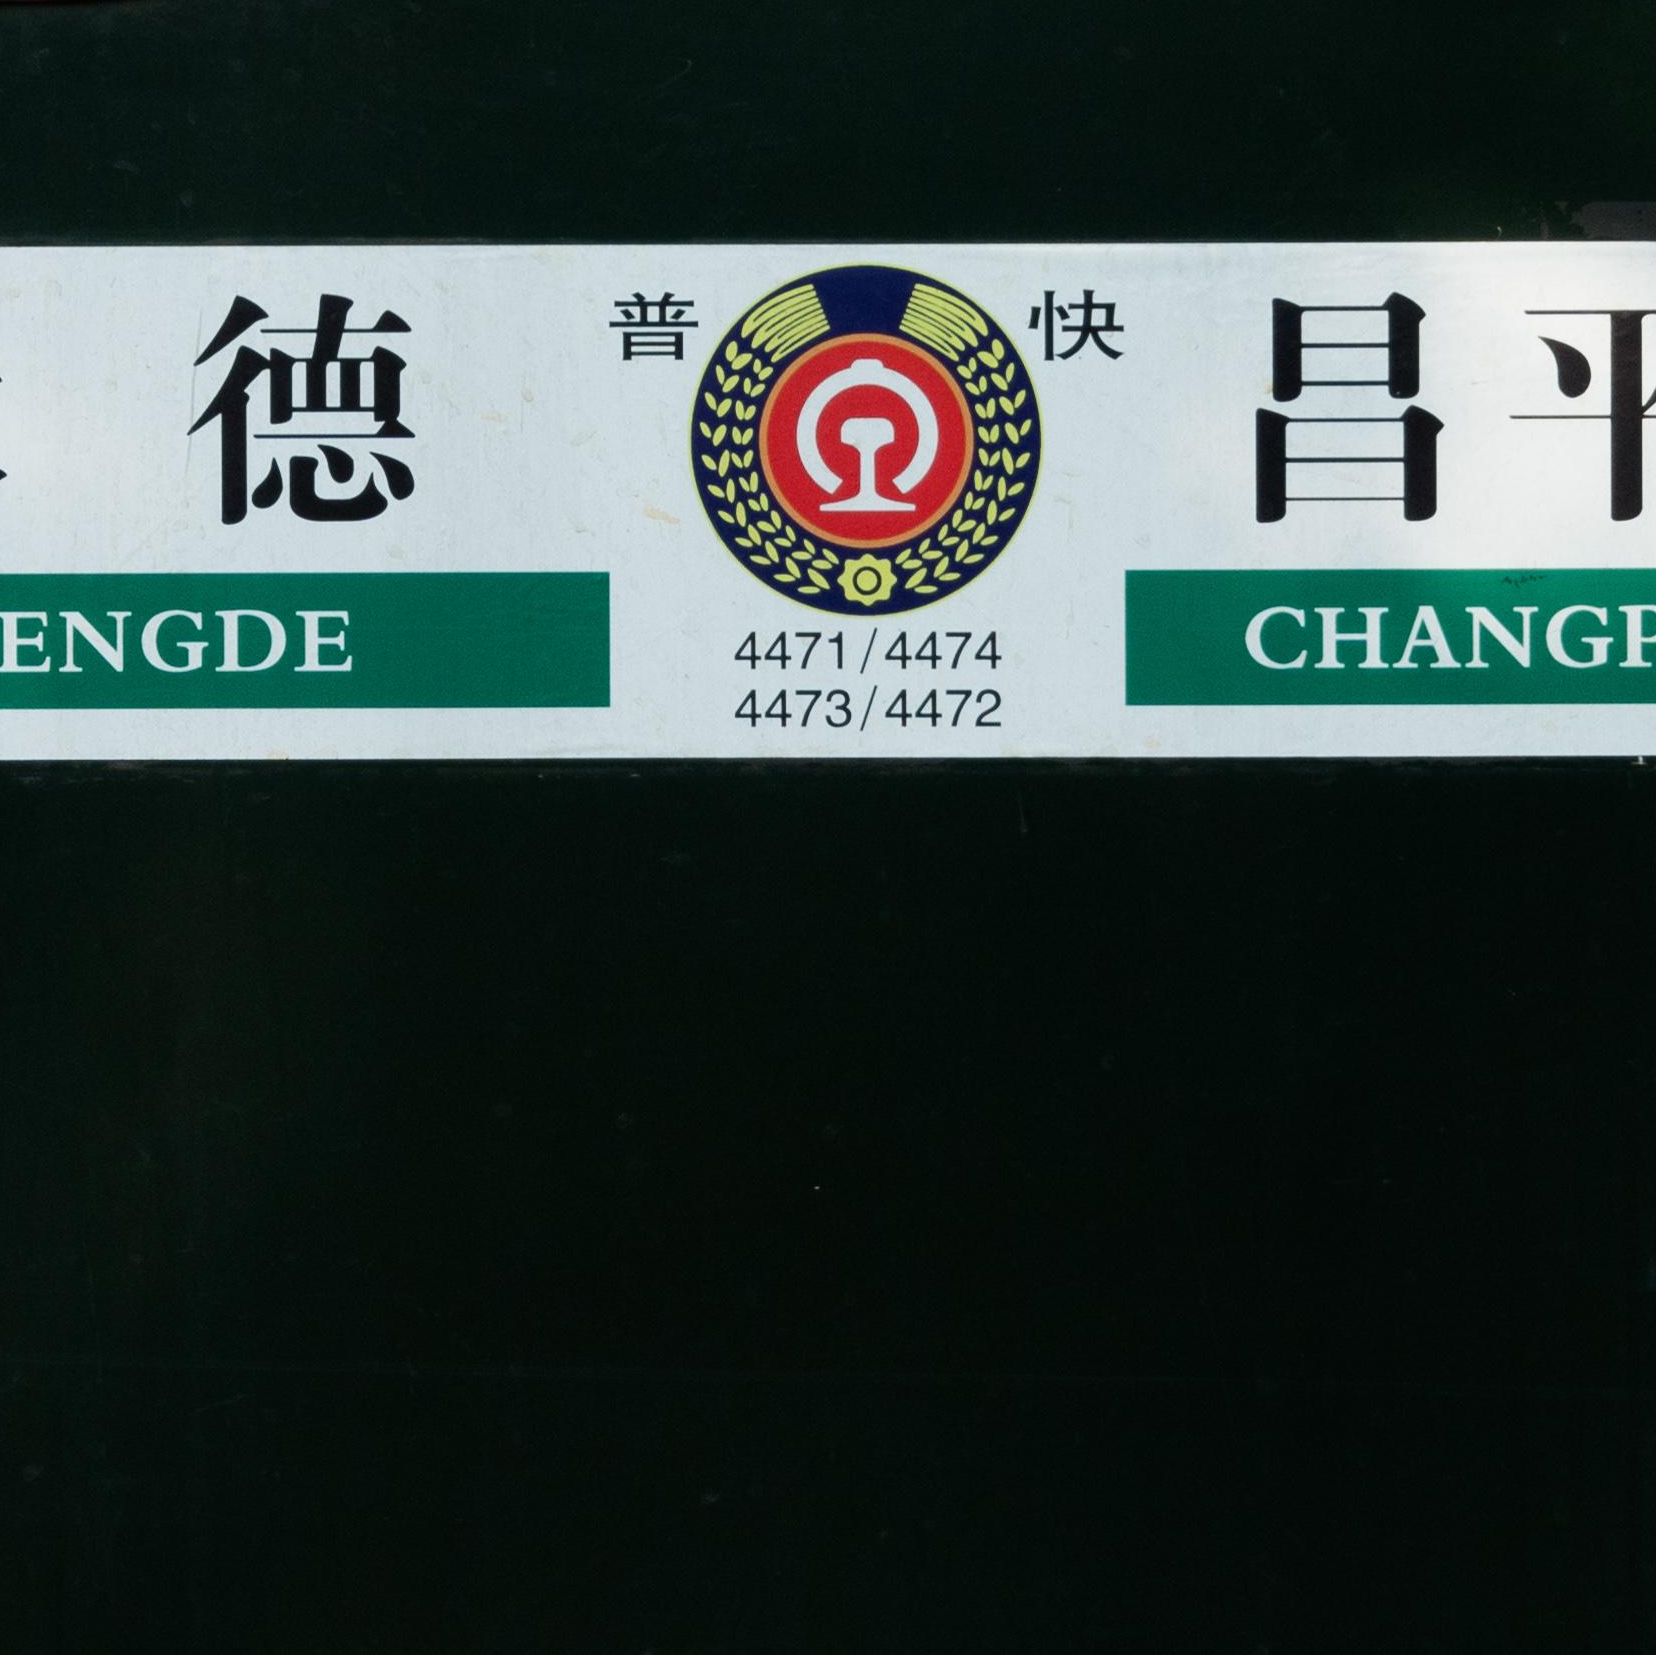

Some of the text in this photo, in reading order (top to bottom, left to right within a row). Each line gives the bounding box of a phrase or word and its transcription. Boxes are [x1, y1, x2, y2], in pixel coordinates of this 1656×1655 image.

[609, 292, 700, 362] 普
[1028, 289, 1126, 362] 快
[734, 628, 1004, 676] 4471/4474
[734, 685, 1004, 733] 4473/4472
